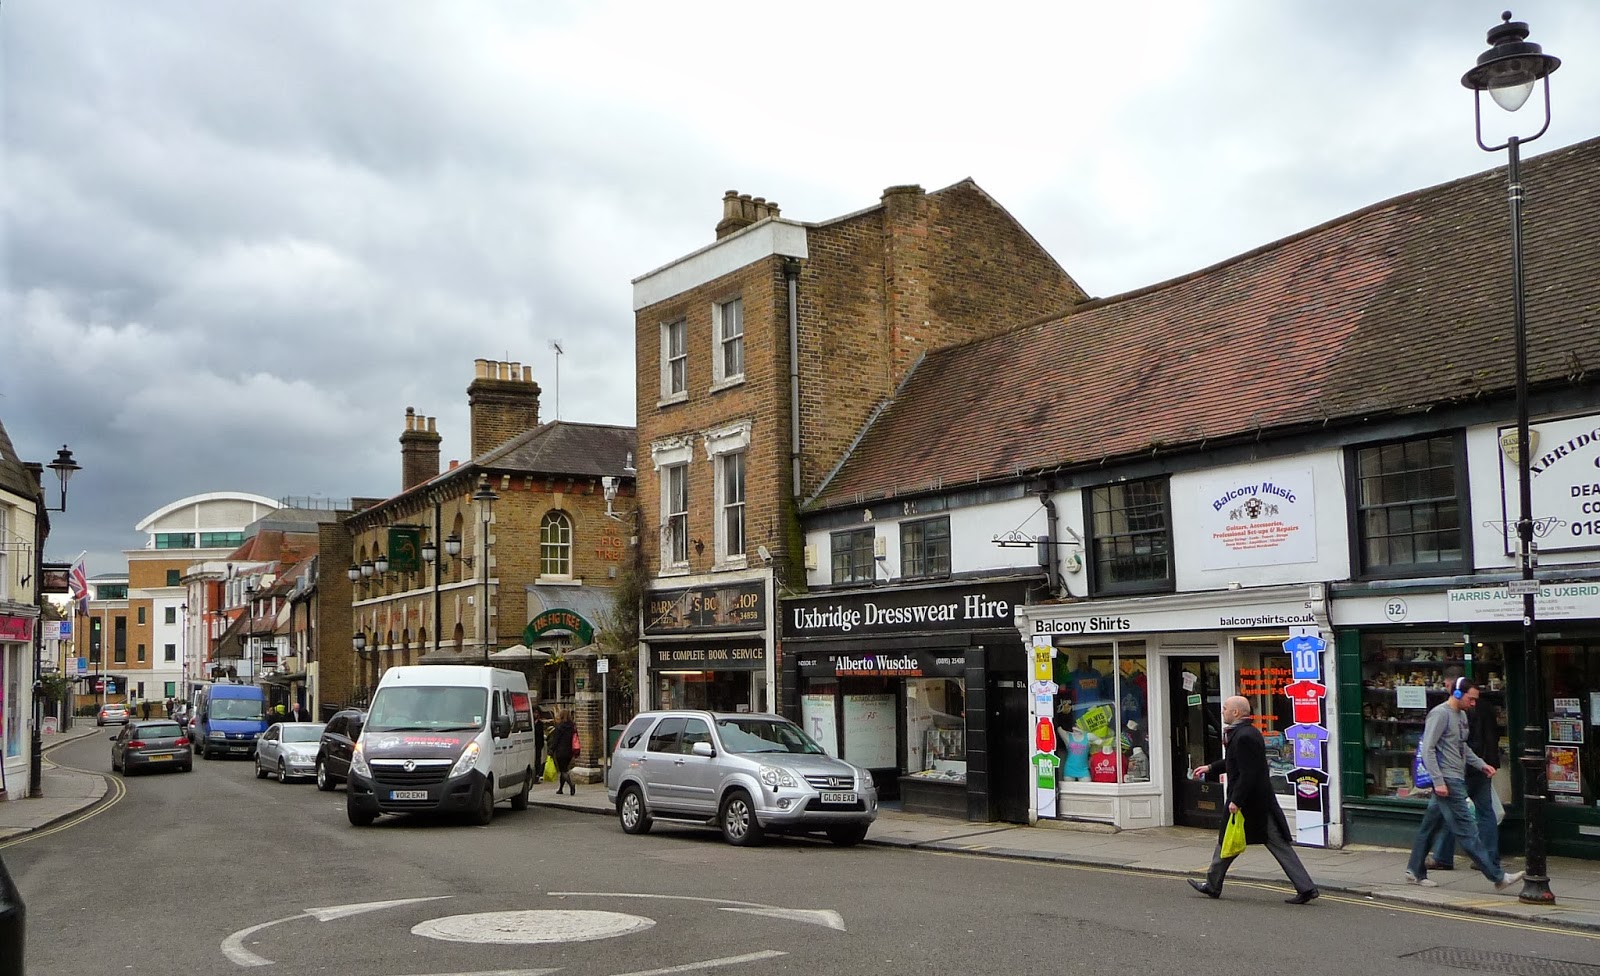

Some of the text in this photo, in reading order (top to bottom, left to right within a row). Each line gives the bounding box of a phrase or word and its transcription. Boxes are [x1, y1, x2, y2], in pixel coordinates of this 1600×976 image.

[1530, 428, 1600, 478] XBRIDG
[1213, 482, 1296, 512] Balcony Music
[1213, 530, 1246, 539] Professional
[1276, 525, 1299, 533] Repairs
[601, 537, 621, 547] FIG
[1451, 591, 1491, 601] HARRIS
[1555, 586, 1599, 597] UXBRID
[794, 594, 1009, 632] Uxbridge Dresswear Hire
[1220, 613, 1315, 626] balconyshirts.co.uk
[533, 613, 581, 632] THE FIG TREE
[1036, 617, 1130, 633] Balcony Shirts
[659, 648, 763, 661] THE COMPLETE BOOK SERVICE
[1295, 650, 1316, 672] 10
[836, 655, 918, 671] Alberto Wusche
[1240, 668, 1261, 676] Retro
[1240, 678, 1277, 686] Imported
[1086, 713, 1105, 725] HI-VIS
